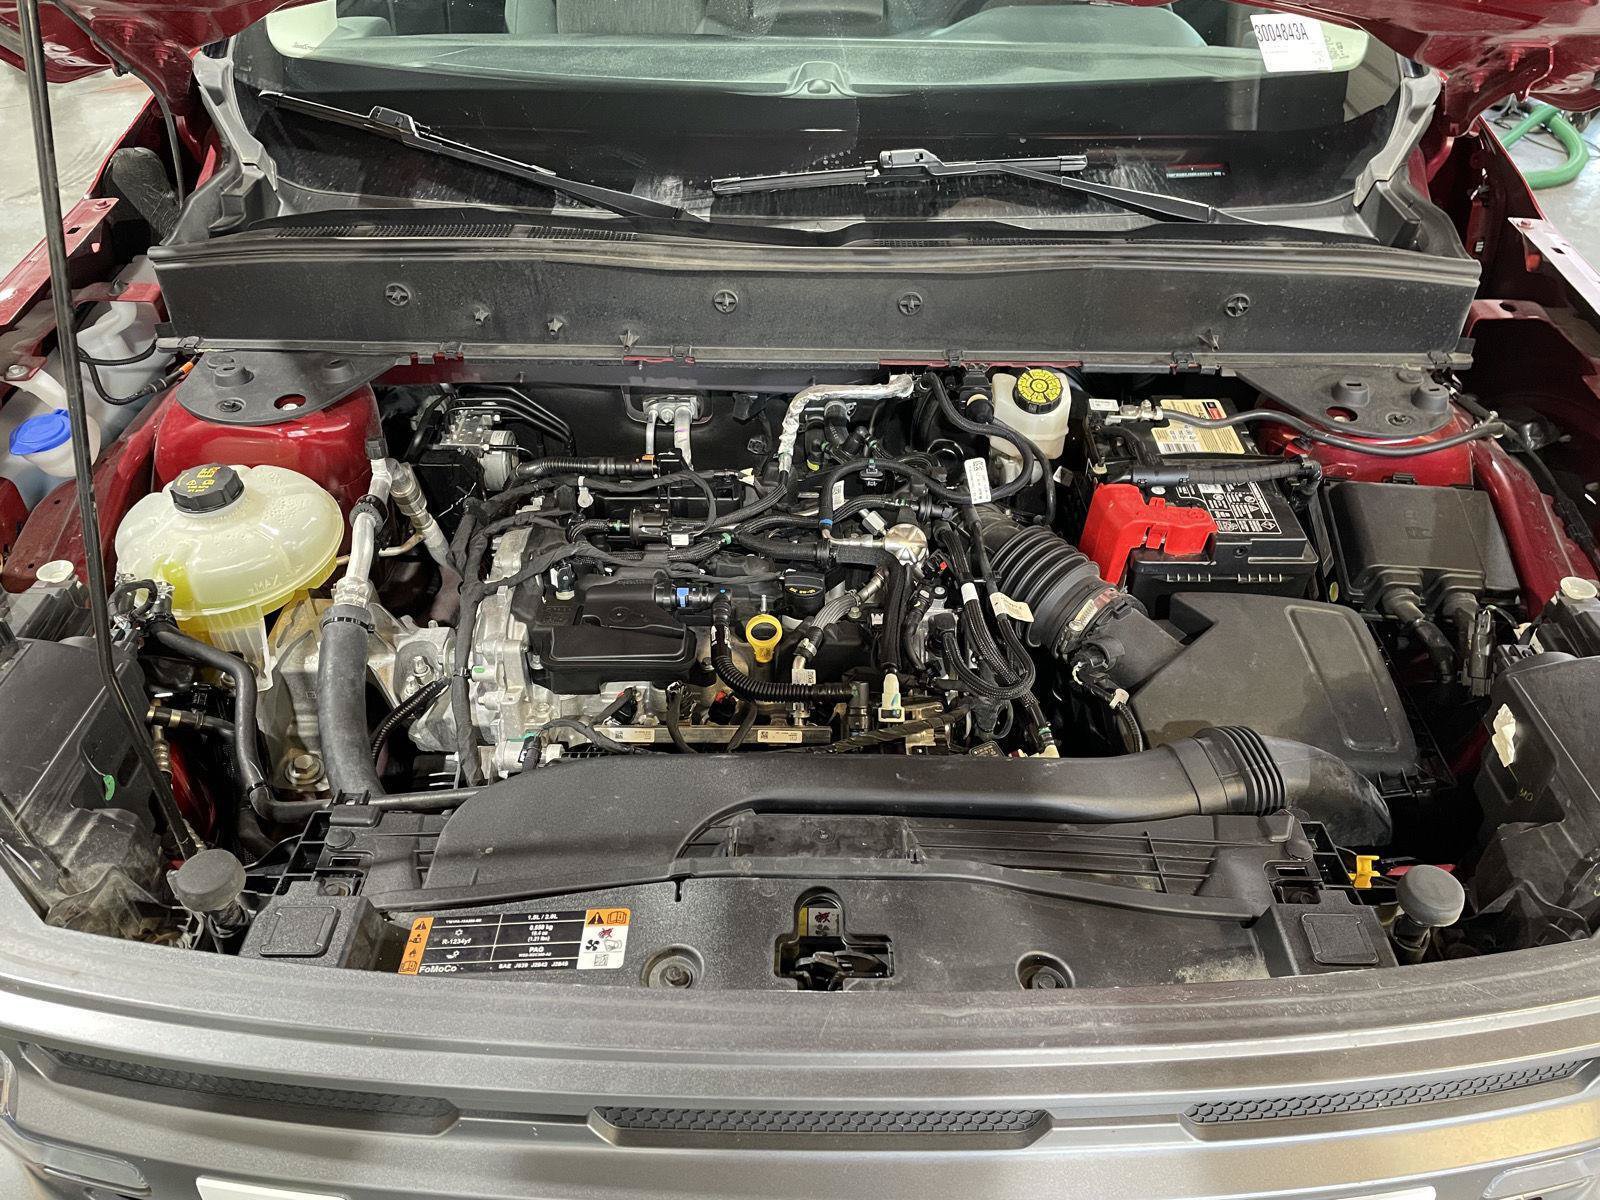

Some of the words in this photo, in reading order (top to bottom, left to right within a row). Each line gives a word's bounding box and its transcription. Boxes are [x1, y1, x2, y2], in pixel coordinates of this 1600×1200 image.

[1254, 22, 1309, 42] 3004843A
[441, 937, 472, 946] R-1234yf
[418, 964, 458, 974] FoMoCo
